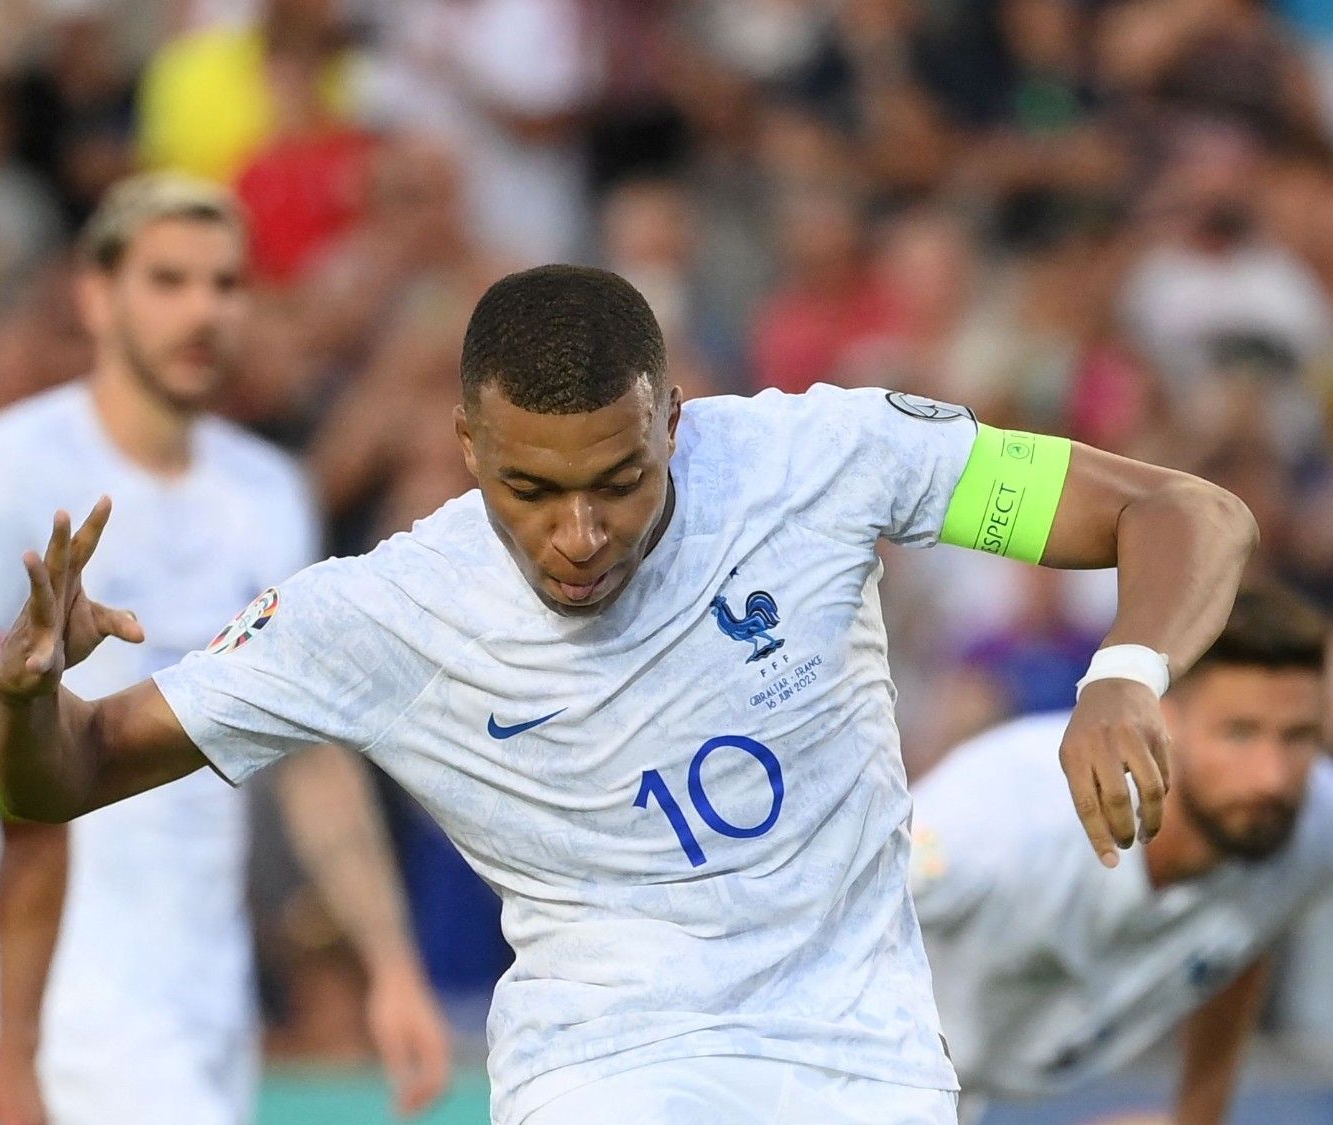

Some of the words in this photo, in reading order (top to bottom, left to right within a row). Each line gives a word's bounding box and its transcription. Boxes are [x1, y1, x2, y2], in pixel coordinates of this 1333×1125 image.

[794, 654, 823, 678] FRANCE
[793, 670, 818, 692] 2023
[632, 734, 785, 867] 10
